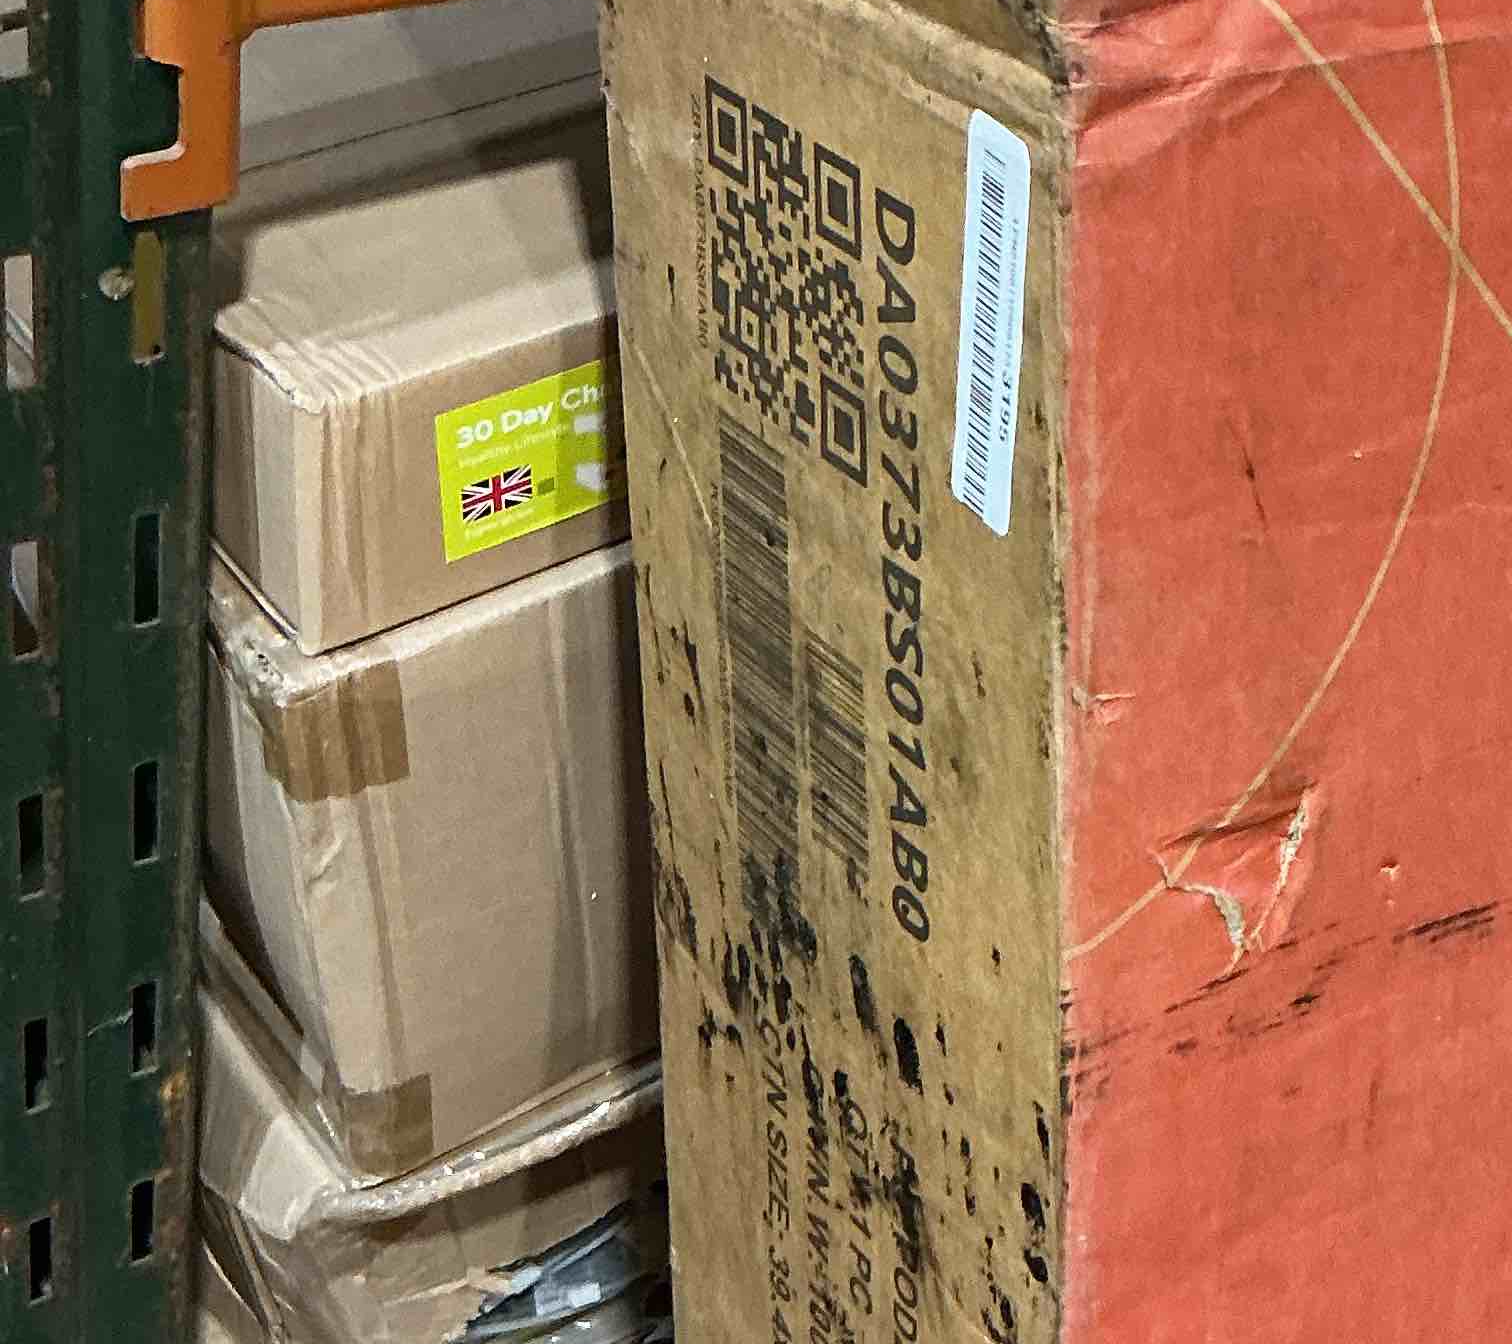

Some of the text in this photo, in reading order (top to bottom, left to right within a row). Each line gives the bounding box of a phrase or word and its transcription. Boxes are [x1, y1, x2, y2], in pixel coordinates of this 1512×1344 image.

[456, 419, 493, 450] 30
[500, 401, 554, 435] Day
[872, 186, 931, 944] DA0373BS01AB0
[758, 1018, 789, 1119] CTN
